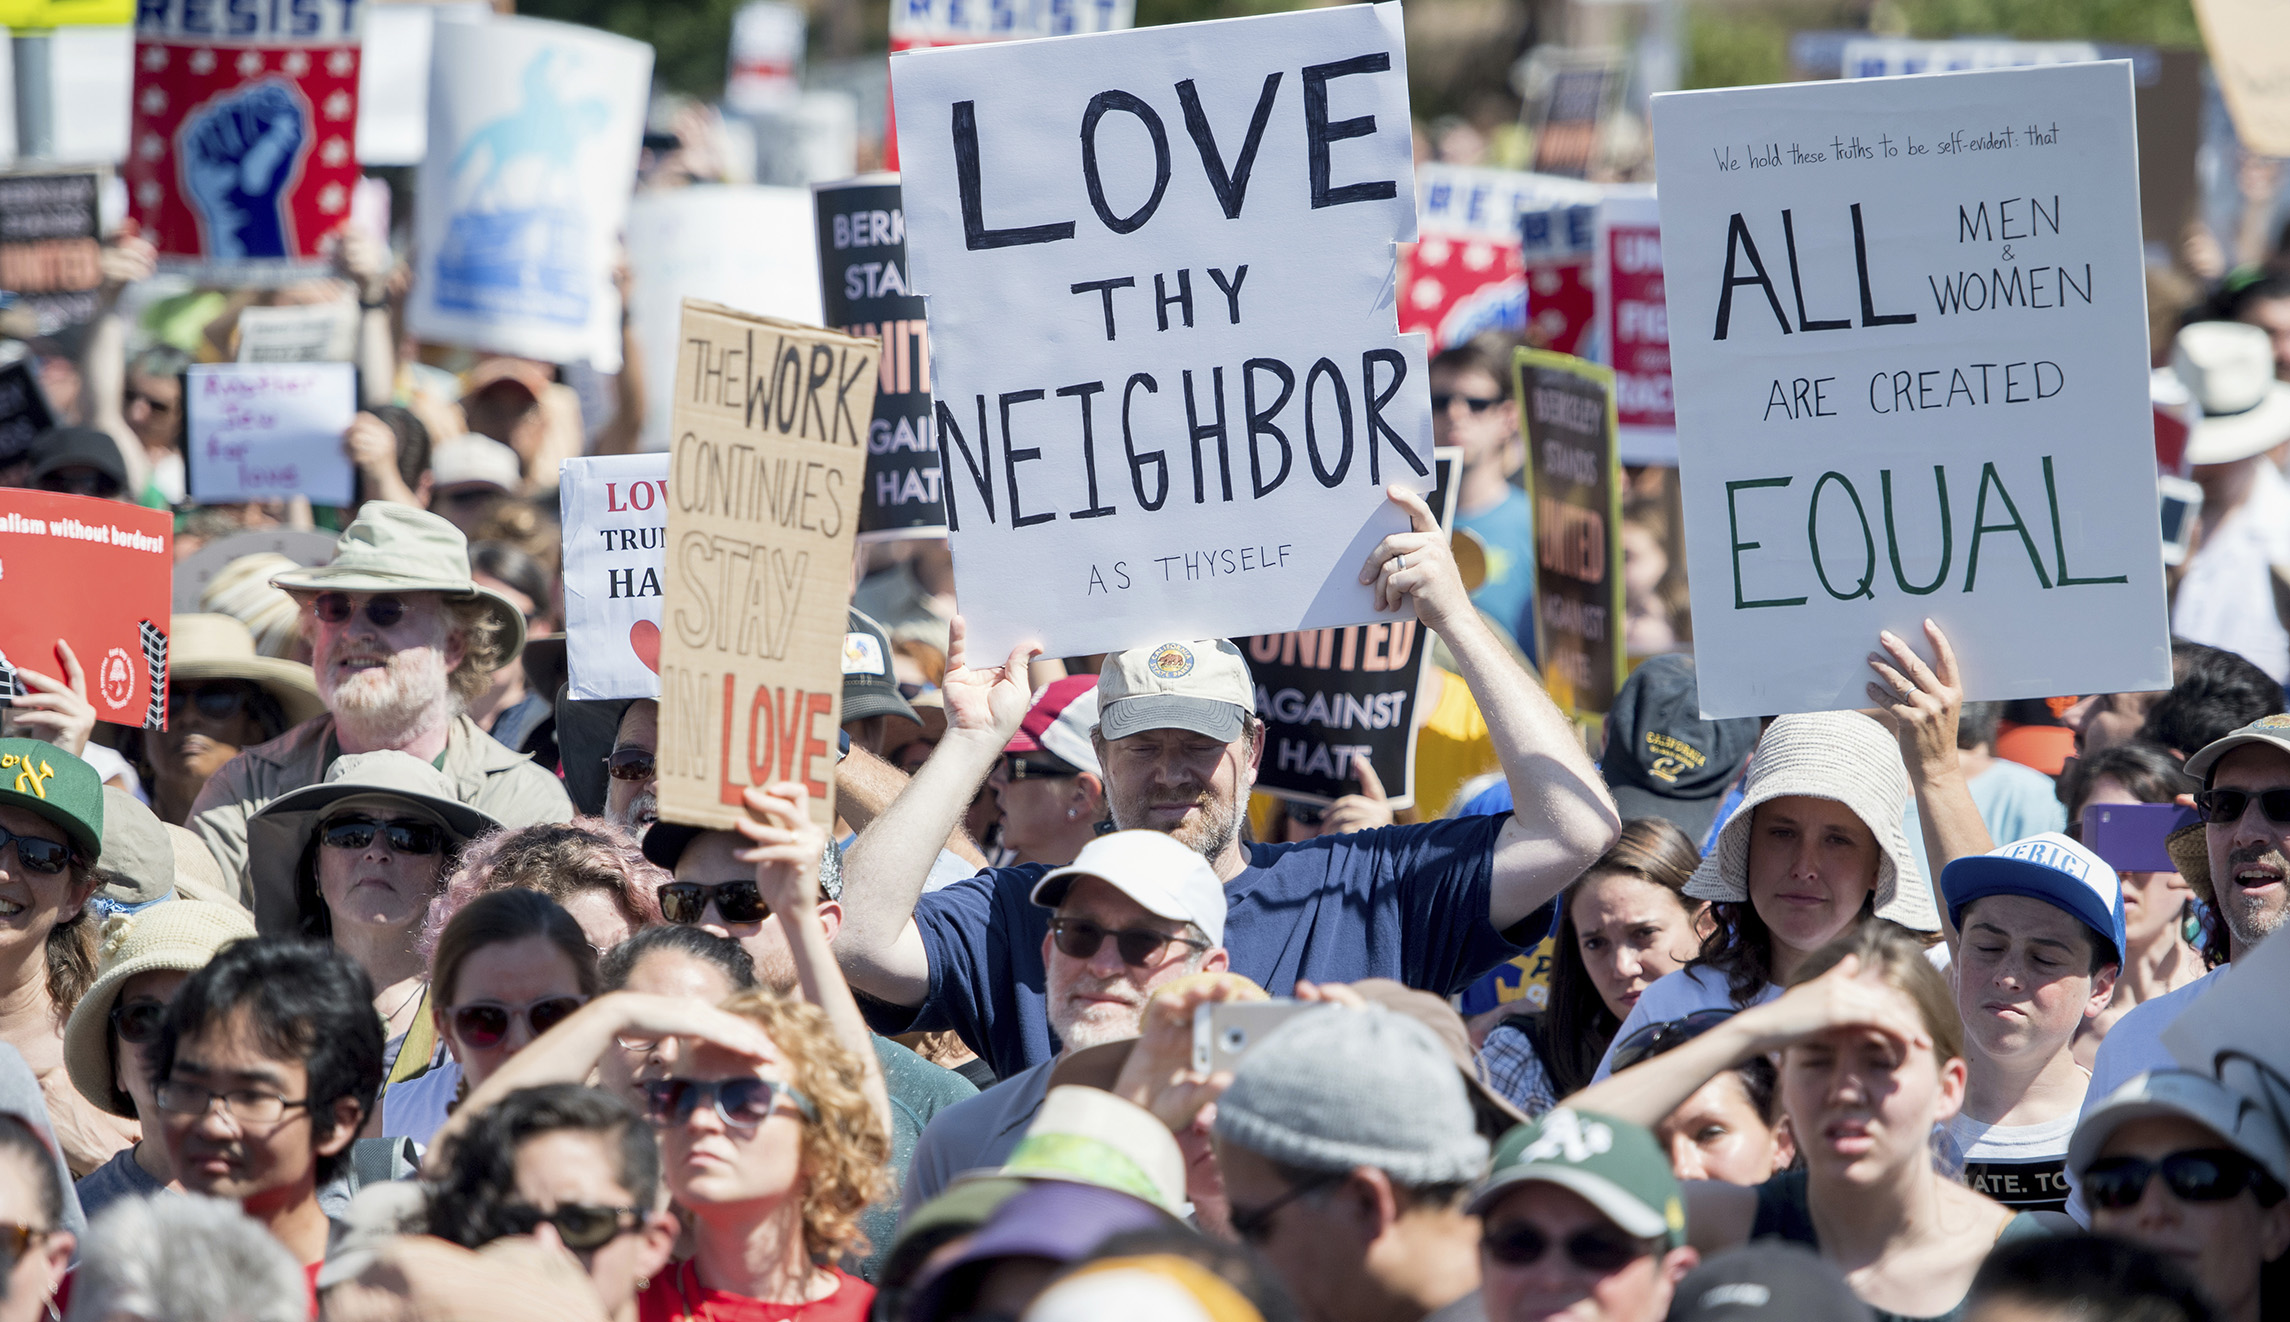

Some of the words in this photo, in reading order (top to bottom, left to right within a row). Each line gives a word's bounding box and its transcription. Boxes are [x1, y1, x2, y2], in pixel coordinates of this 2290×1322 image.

[951, 51, 1397, 251] LOVE
[1713, 146, 1741, 172] We
[1749, 142, 1783, 169] hold
[1787, 143, 1827, 166] these
[1830, 135, 1874, 161] truths
[1879, 133, 1898, 158] to
[1908, 136, 1930, 156] be
[2024, 121, 2060, 146] that
[1959, 195, 2059, 242] MEN
[1713, 203, 1917, 340] ALL
[2002, 244, 2016, 261] &
[1070, 264, 1248, 340] THY
[1928, 264, 2092, 315] WOMEN
[687, 338, 743, 408] THE
[745, 329, 869, 447] WORK
[1763, 377, 1837, 421] ARE
[1869, 361, 2064, 414] CREATED
[935, 348, 1430, 532] NEIGHBOR
[676, 431, 843, 538] CONTINUES
[49, 517, 109, 543] without
[111, 524, 165, 554] borders!
[1726, 456, 2129, 609] EQUAL
[608, 567, 664, 598] HA
[674, 530, 808, 661] STAY
[1088, 561, 1131, 596] AS
[1153, 544, 1292, 582] THYSELF
[664, 665, 710, 780] IN
[720, 673, 832, 806] LOVE
[1255, 683, 1408, 731] AGAINST
[1645, 731, 1706, 767] CALIFORNIA
